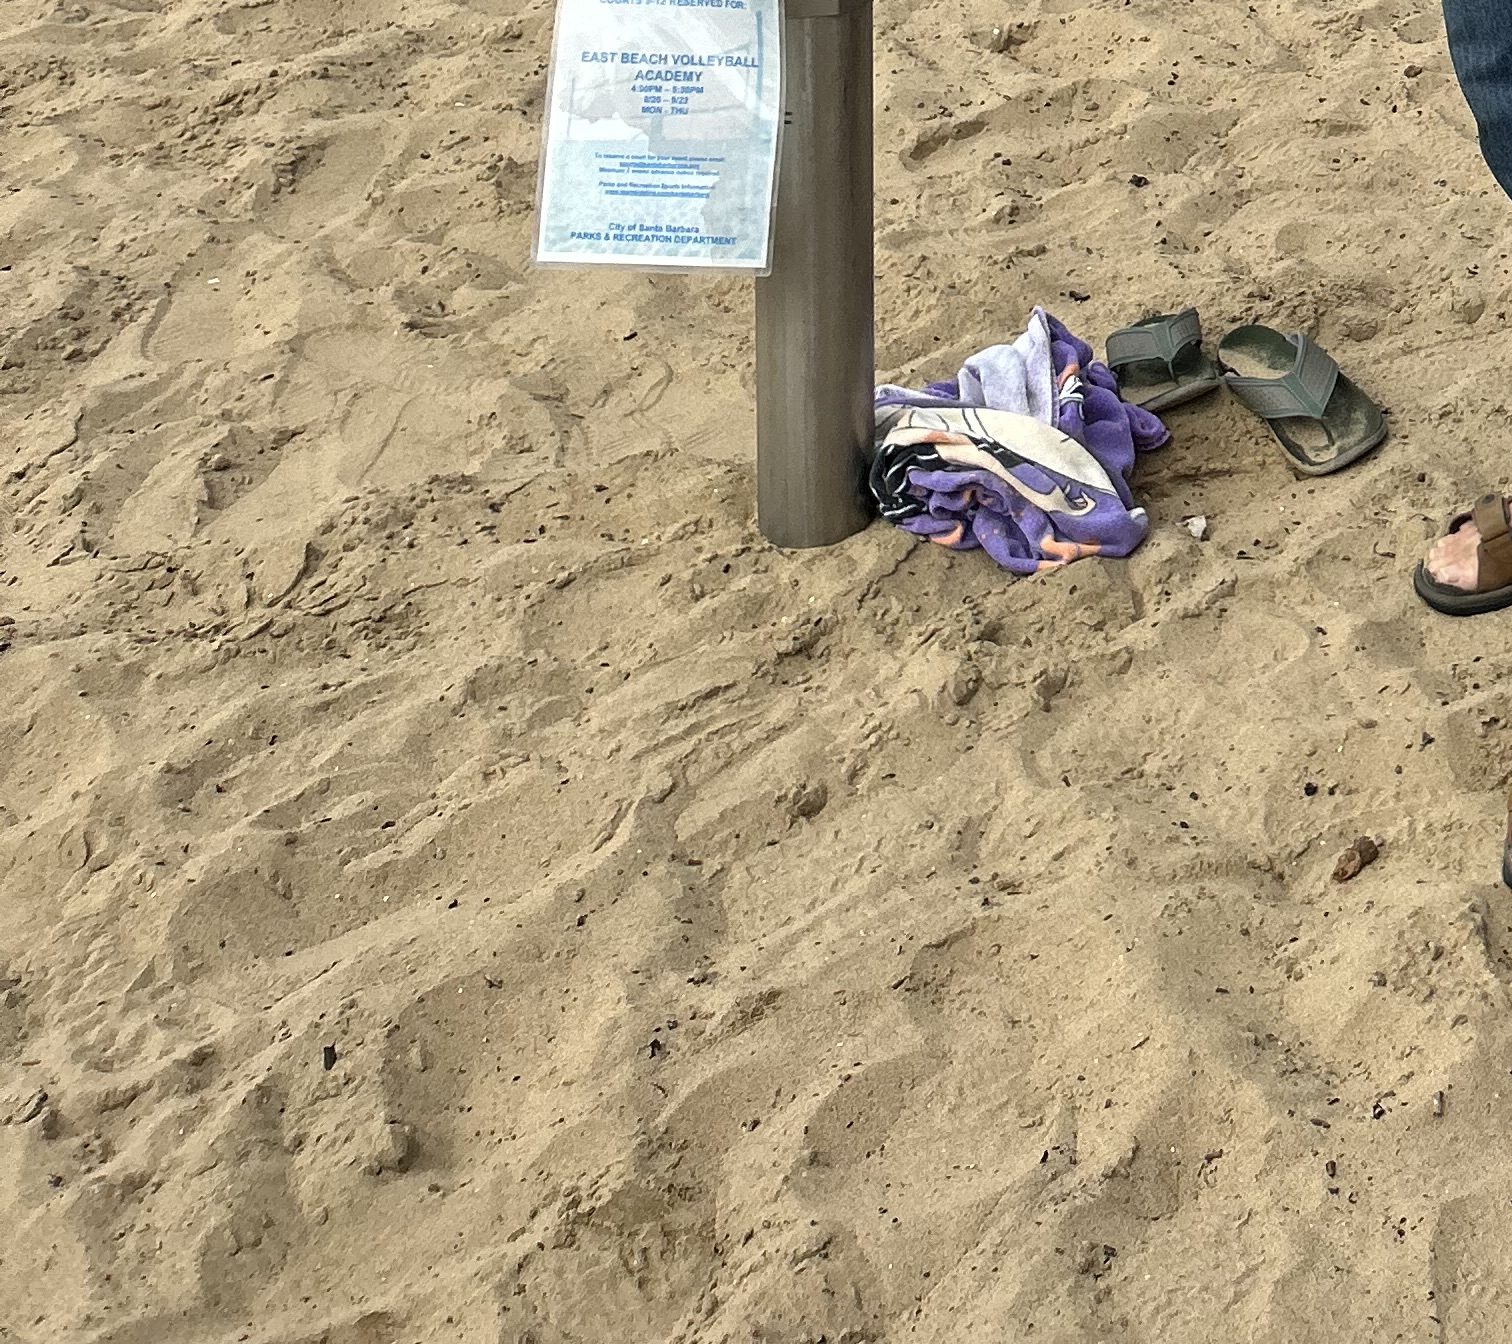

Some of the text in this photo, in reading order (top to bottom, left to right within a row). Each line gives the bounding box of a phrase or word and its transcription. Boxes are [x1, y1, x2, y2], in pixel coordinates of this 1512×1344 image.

[581, 51, 760, 68] EAST BEACH VOLLEYBALL
[634, 69, 703, 82] ACADEMY
[641, 106, 663, 115] MON
[670, 106, 689, 115] THU
[608, 222, 700, 234] City of Santa Barbara
[570, 231, 737, 245] PARKS & RECREATION DEPARTMENT
